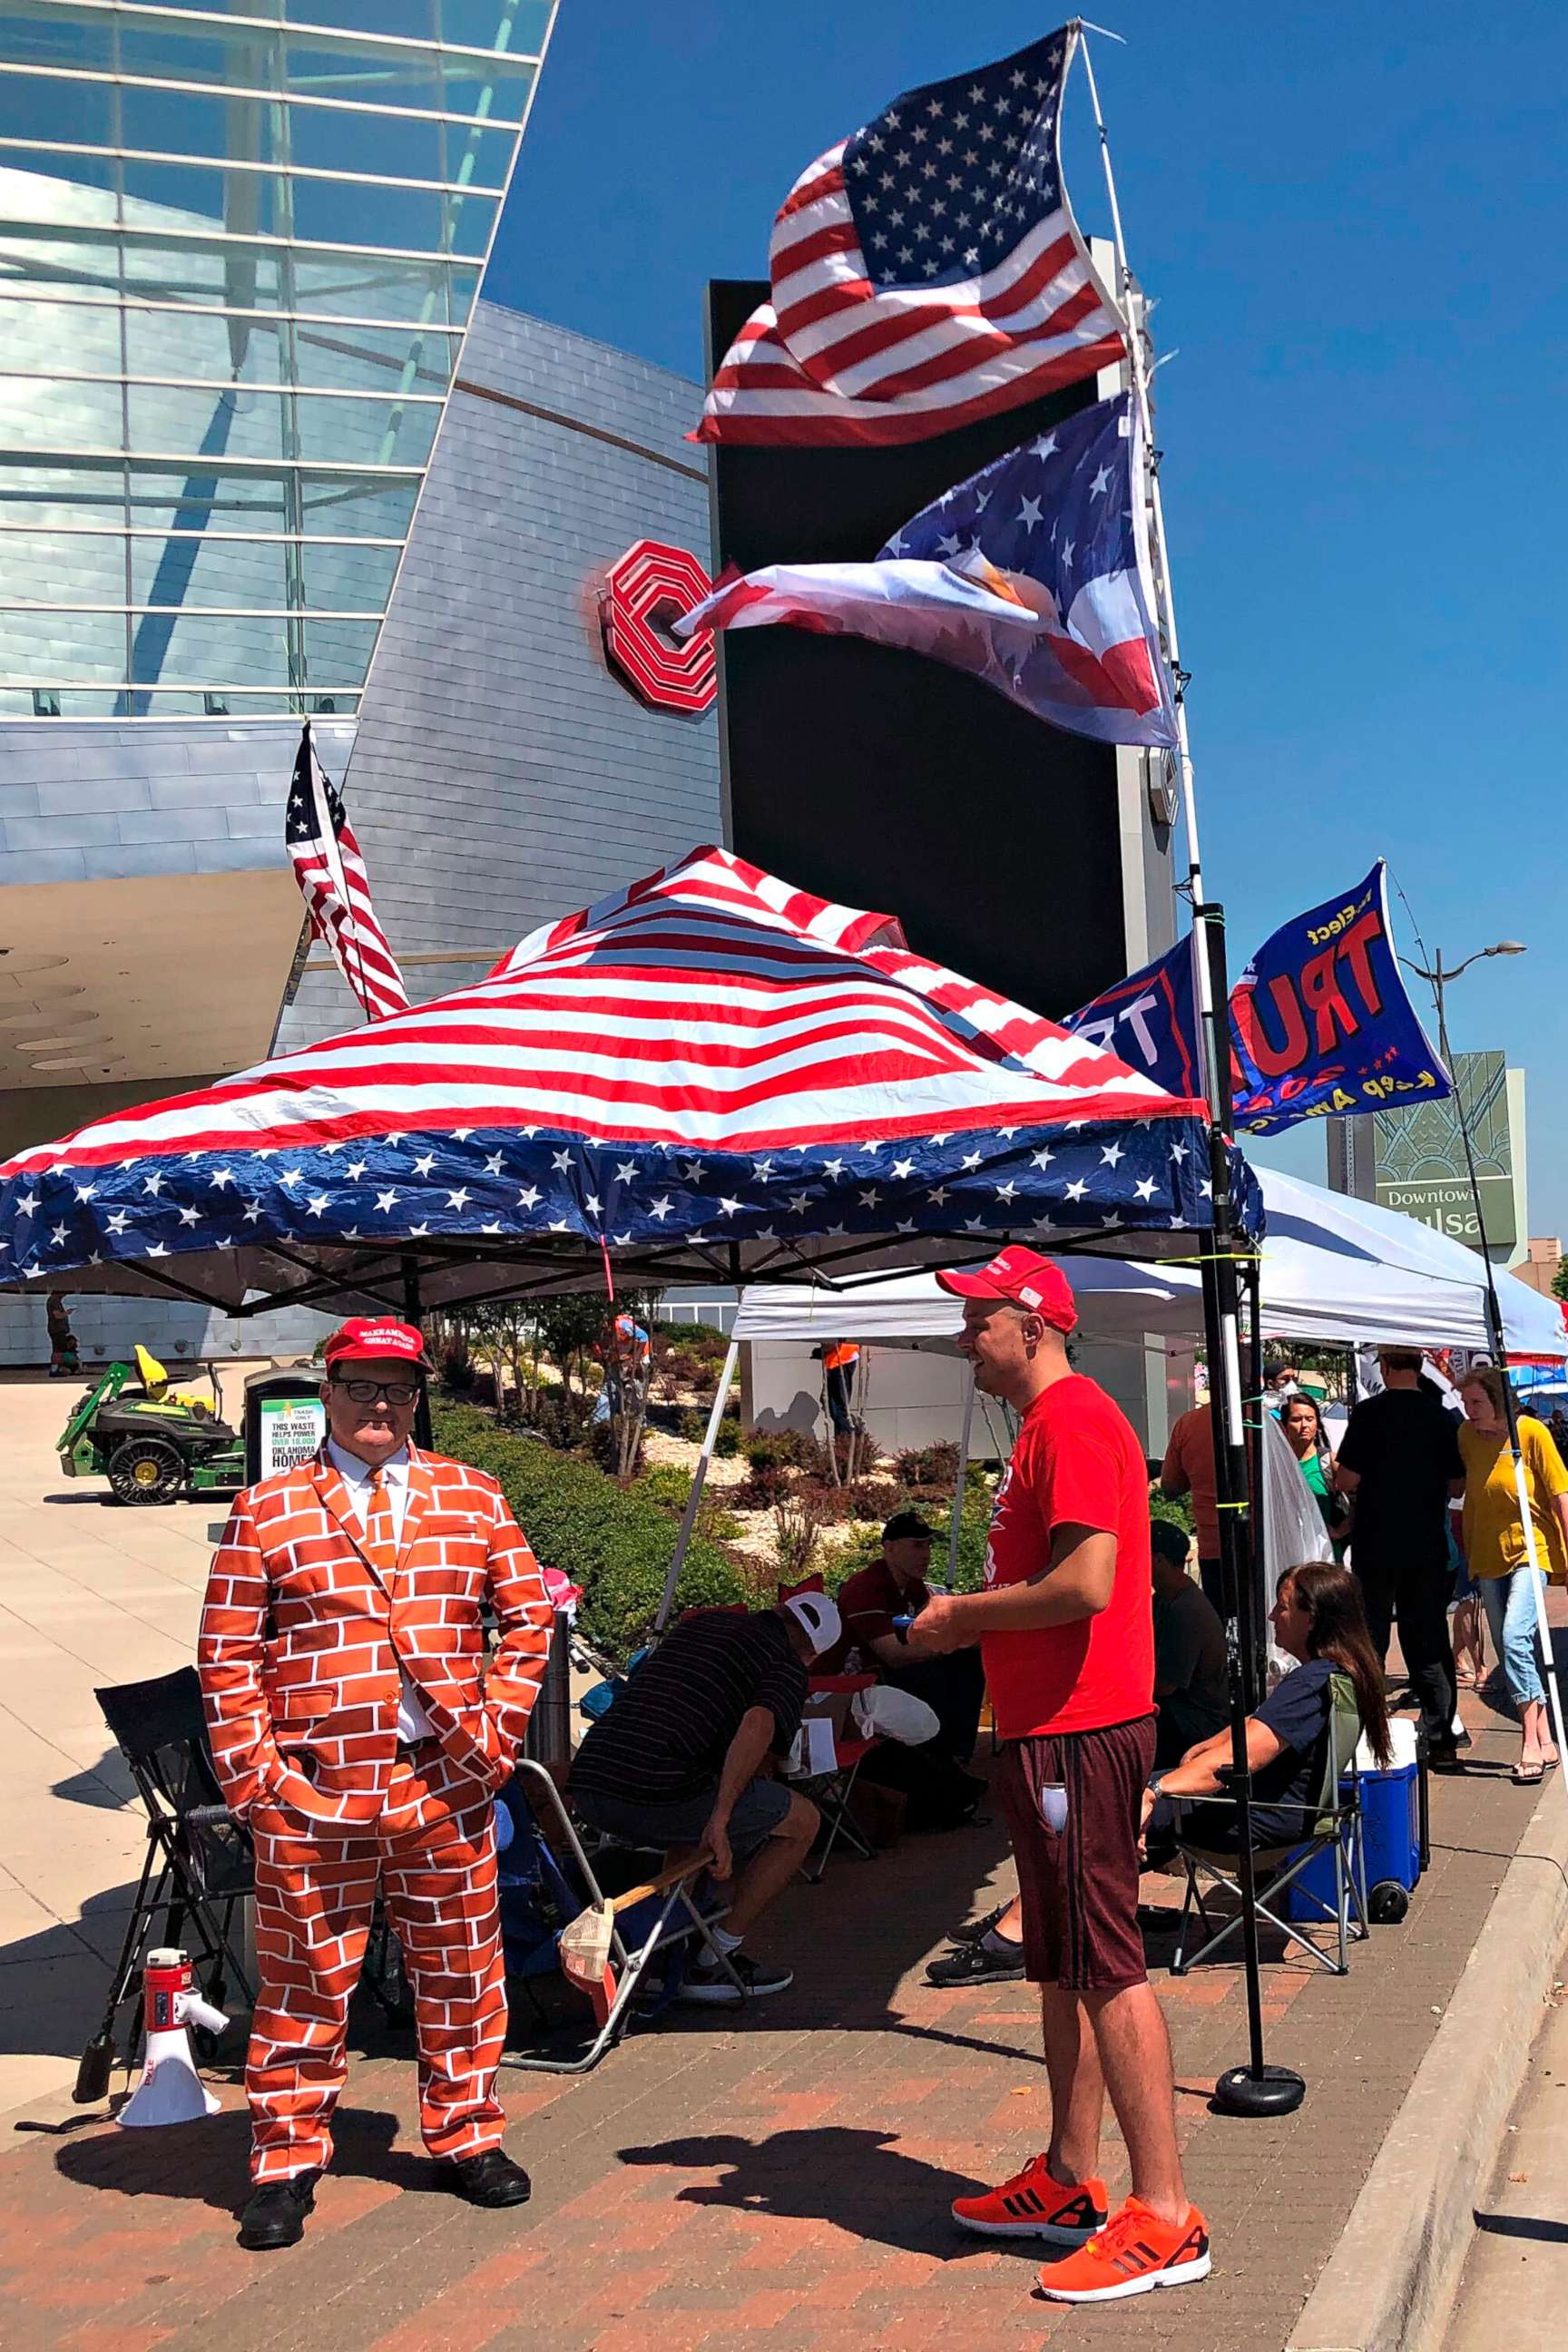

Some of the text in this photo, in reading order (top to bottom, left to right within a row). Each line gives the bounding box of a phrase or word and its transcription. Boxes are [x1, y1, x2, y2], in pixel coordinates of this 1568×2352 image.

[1388, 1188, 1481, 1206] Downtown
[1400, 1208, 1481, 1235] ulsa
[359, 1328, 416, 1344] MAKE AMERICA
[364, 1337, 392, 1345] GREAT
[272, 1422, 315, 1431] THIS WASTE
[272, 1446, 315, 1455] OKLAHOMA
[272, 1454, 314, 1467] HOM
